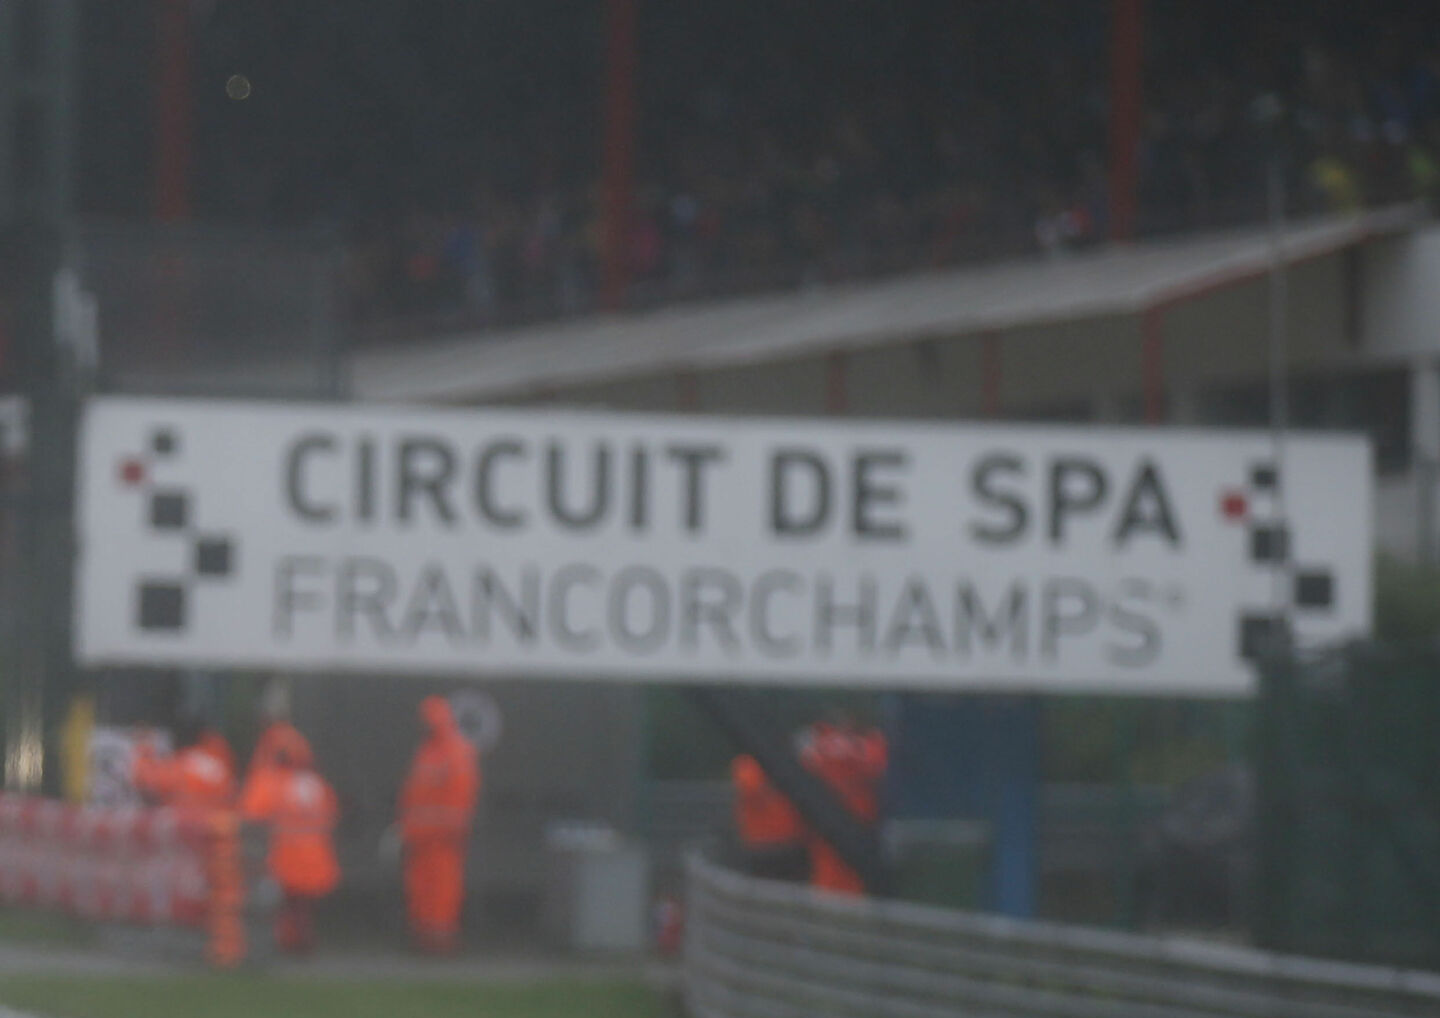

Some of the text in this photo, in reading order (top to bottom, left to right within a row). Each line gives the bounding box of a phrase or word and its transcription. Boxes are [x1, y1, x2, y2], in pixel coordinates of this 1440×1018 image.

[281, 432, 1182, 550] CIRCUIT DE SPA
[274, 555, 1166, 673] FRANCORCHAMPS
